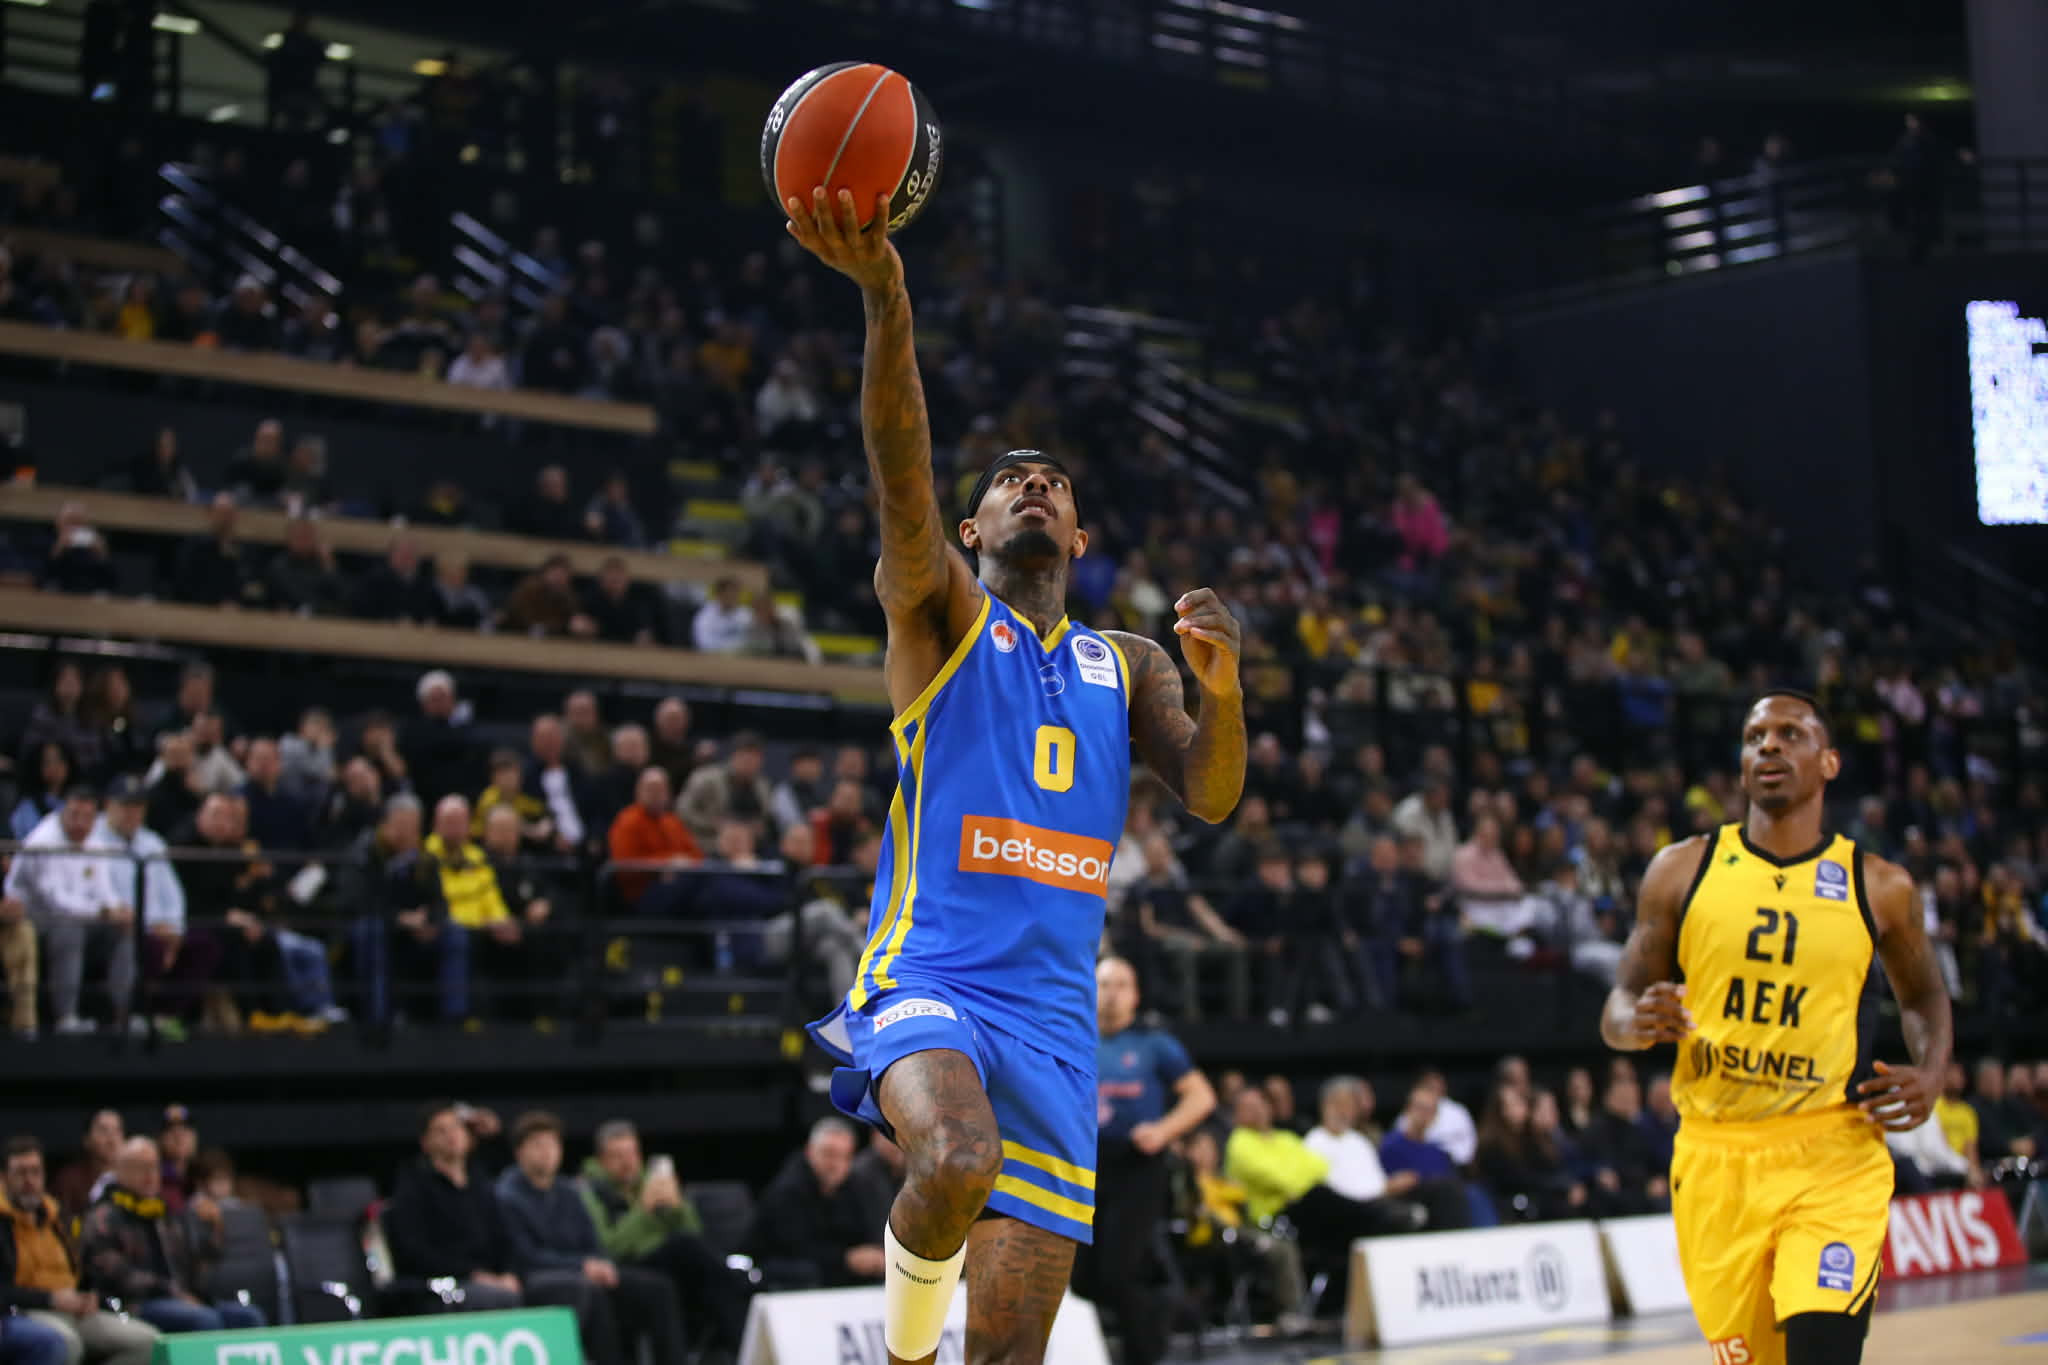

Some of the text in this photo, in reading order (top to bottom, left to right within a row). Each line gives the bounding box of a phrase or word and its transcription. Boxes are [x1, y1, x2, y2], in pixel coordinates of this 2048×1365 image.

[886, 123, 941, 232] PALDING
[1033, 725, 1076, 793] 0
[1745, 907, 1798, 965] 21
[876, 1006, 947, 1028] YOURS
[1723, 977, 1808, 1028] AEK
[1723, 1045, 1825, 1083] SUNEL
[1889, 1191, 1999, 1276] AVIS
[1416, 1264, 1521, 1308] Allianz
